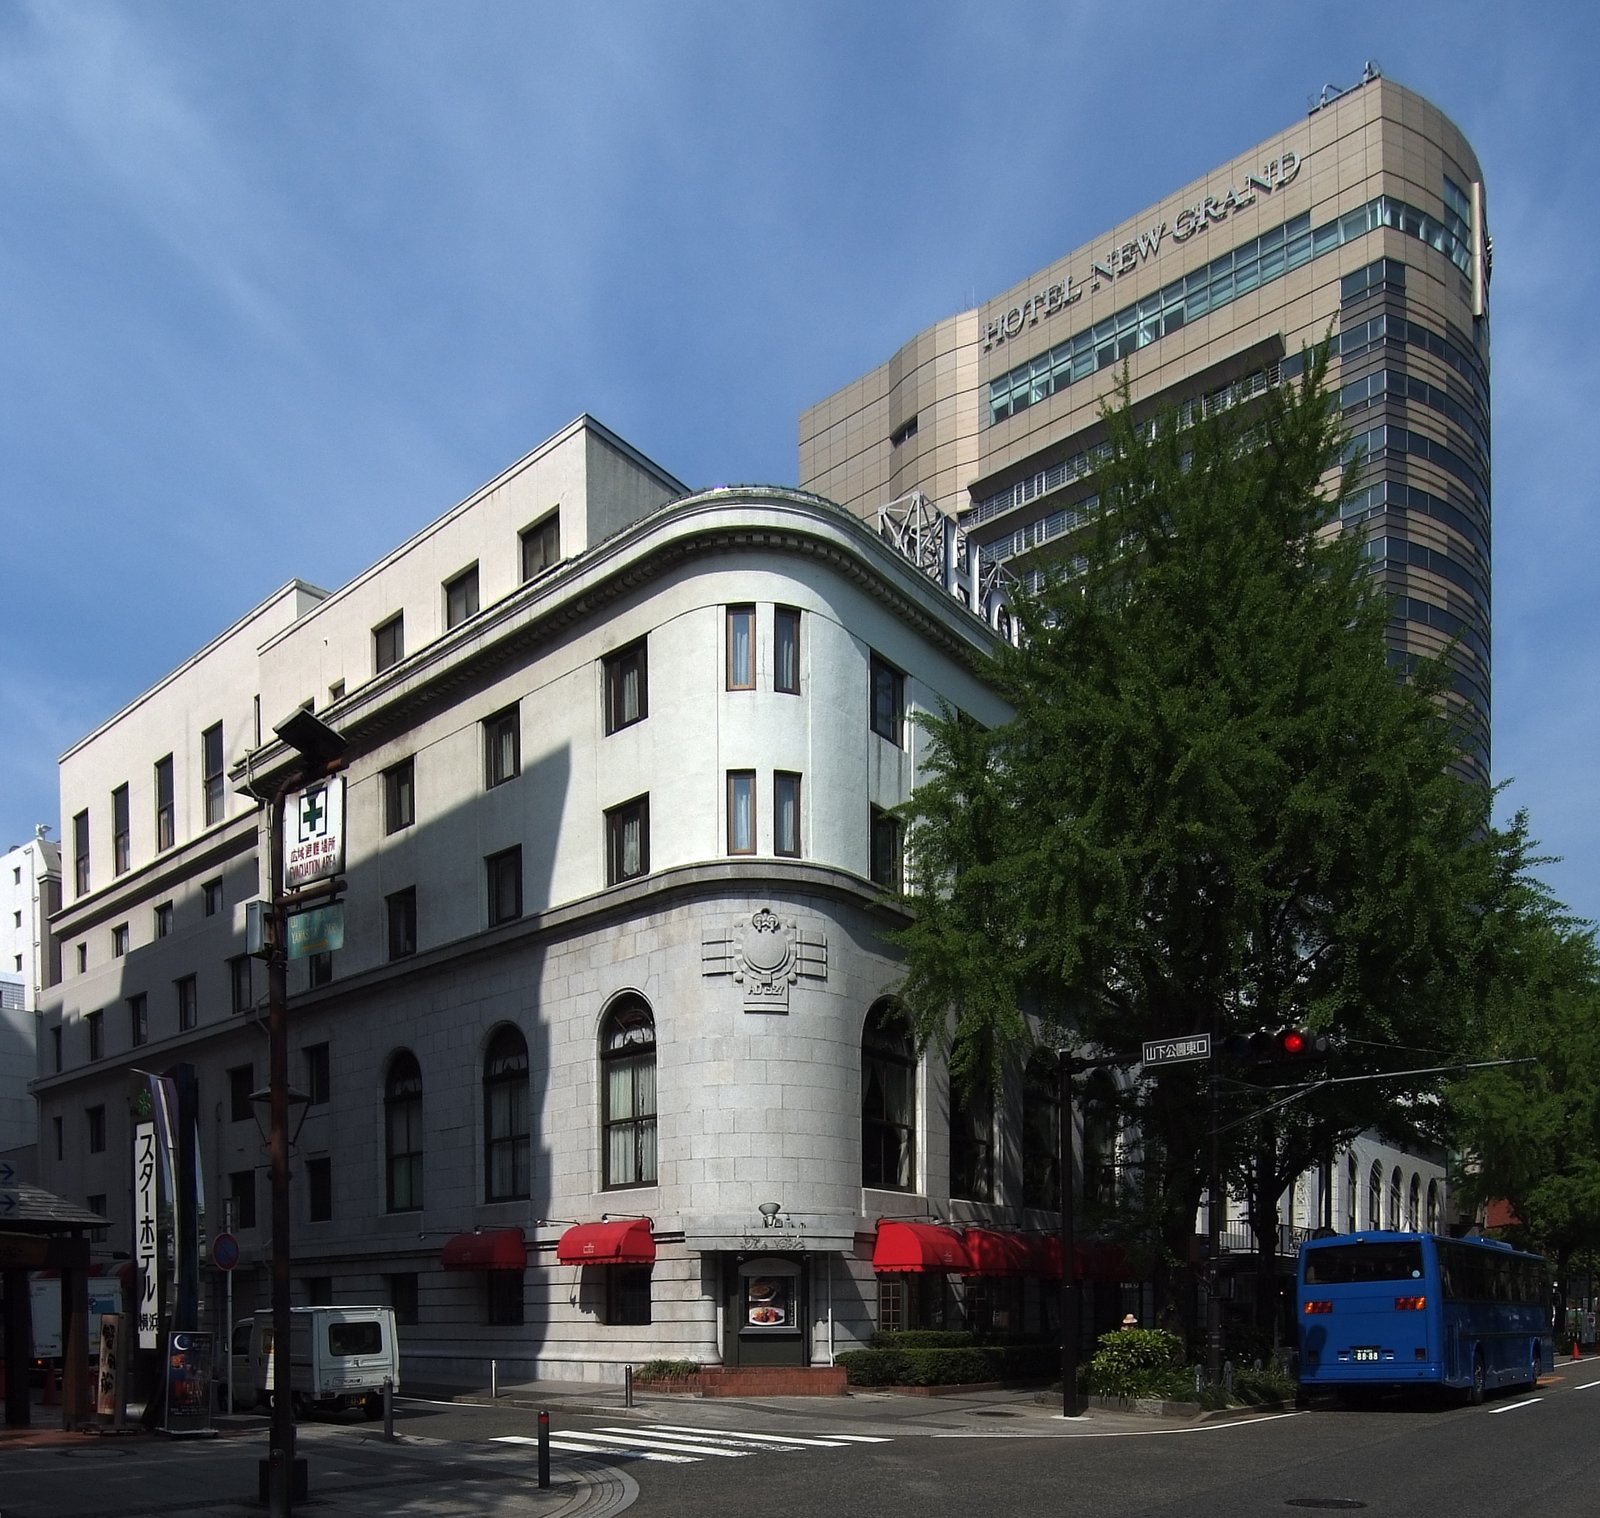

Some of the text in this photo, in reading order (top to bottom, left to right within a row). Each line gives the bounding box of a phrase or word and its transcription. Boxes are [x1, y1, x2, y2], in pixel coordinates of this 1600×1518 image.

[983, 151, 1302, 351] HOTEL NEW GRAND
[1146, 1040, 1207, 1061] 山下公園東口
[138, 1134, 157, 1303] スターホテル
